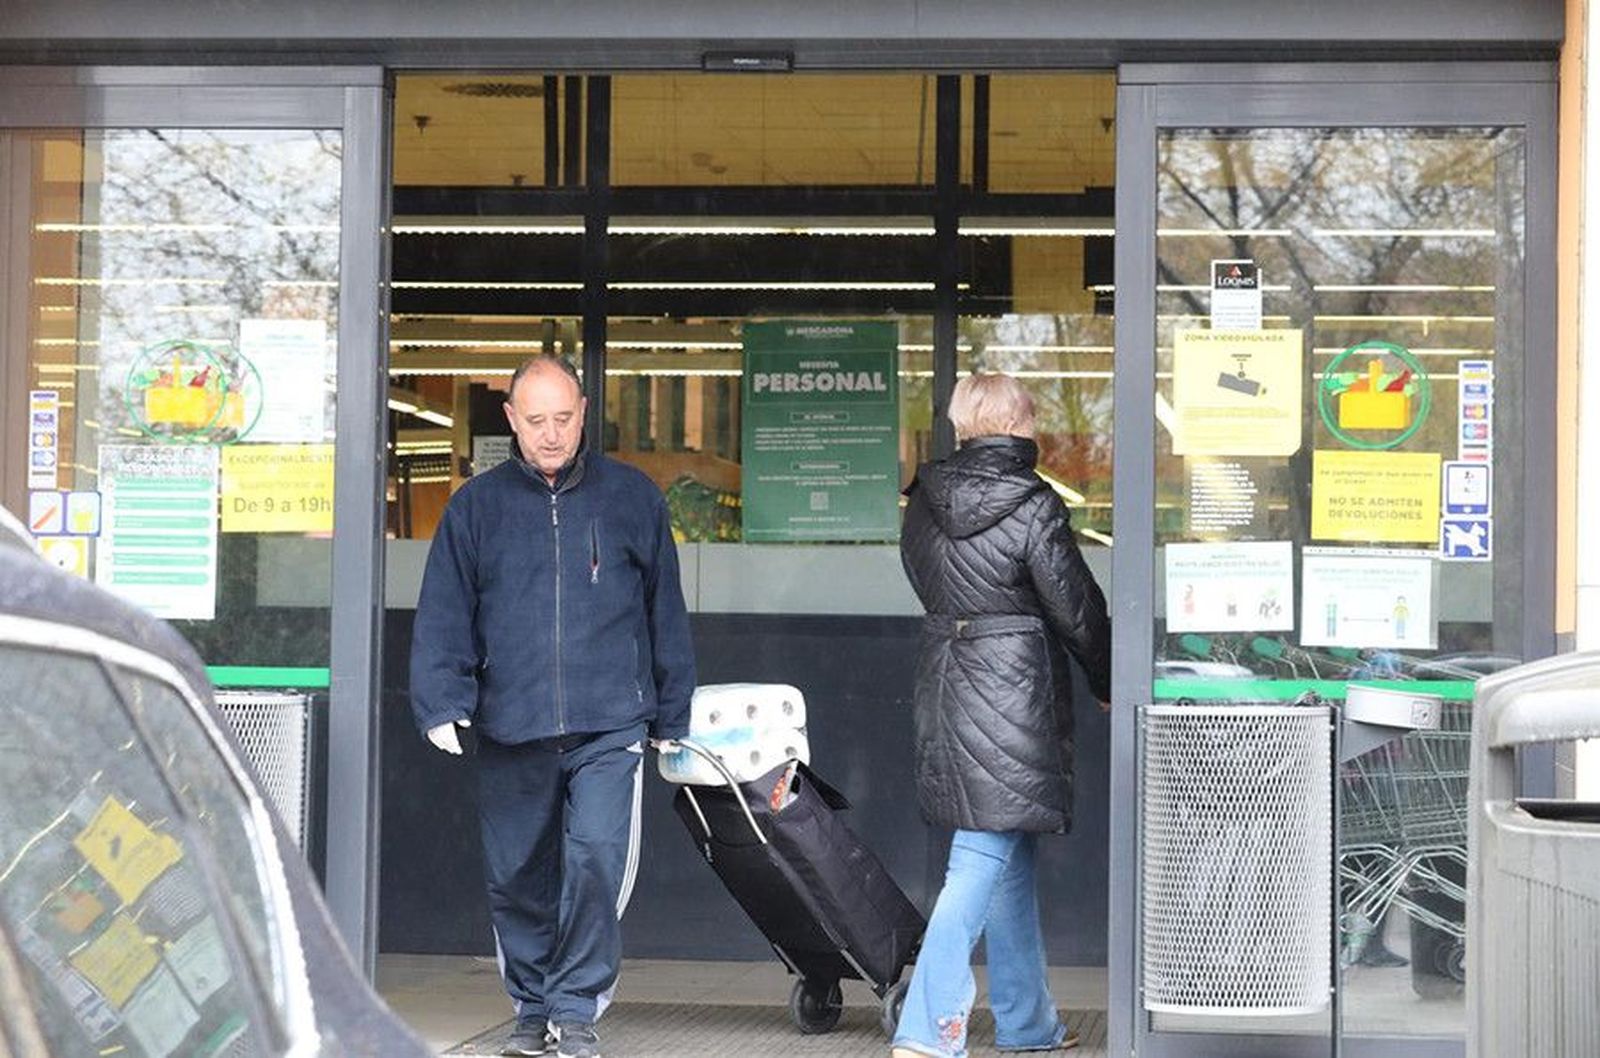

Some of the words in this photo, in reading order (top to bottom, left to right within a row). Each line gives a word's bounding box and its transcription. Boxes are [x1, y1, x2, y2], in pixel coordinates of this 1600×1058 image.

[753, 372, 887, 393] PERSONAL
[233, 497, 257, 513] De
[264, 497, 275, 513] 9
[281, 500, 291, 513] a
[299, 497, 331, 513] 19h
[1328, 497, 1347, 506] NO
[1350, 497, 1365, 506] SE
[1368, 497, 1424, 508] ADMITEN
[1328, 509, 1424, 521] DEVOLUCIONES
